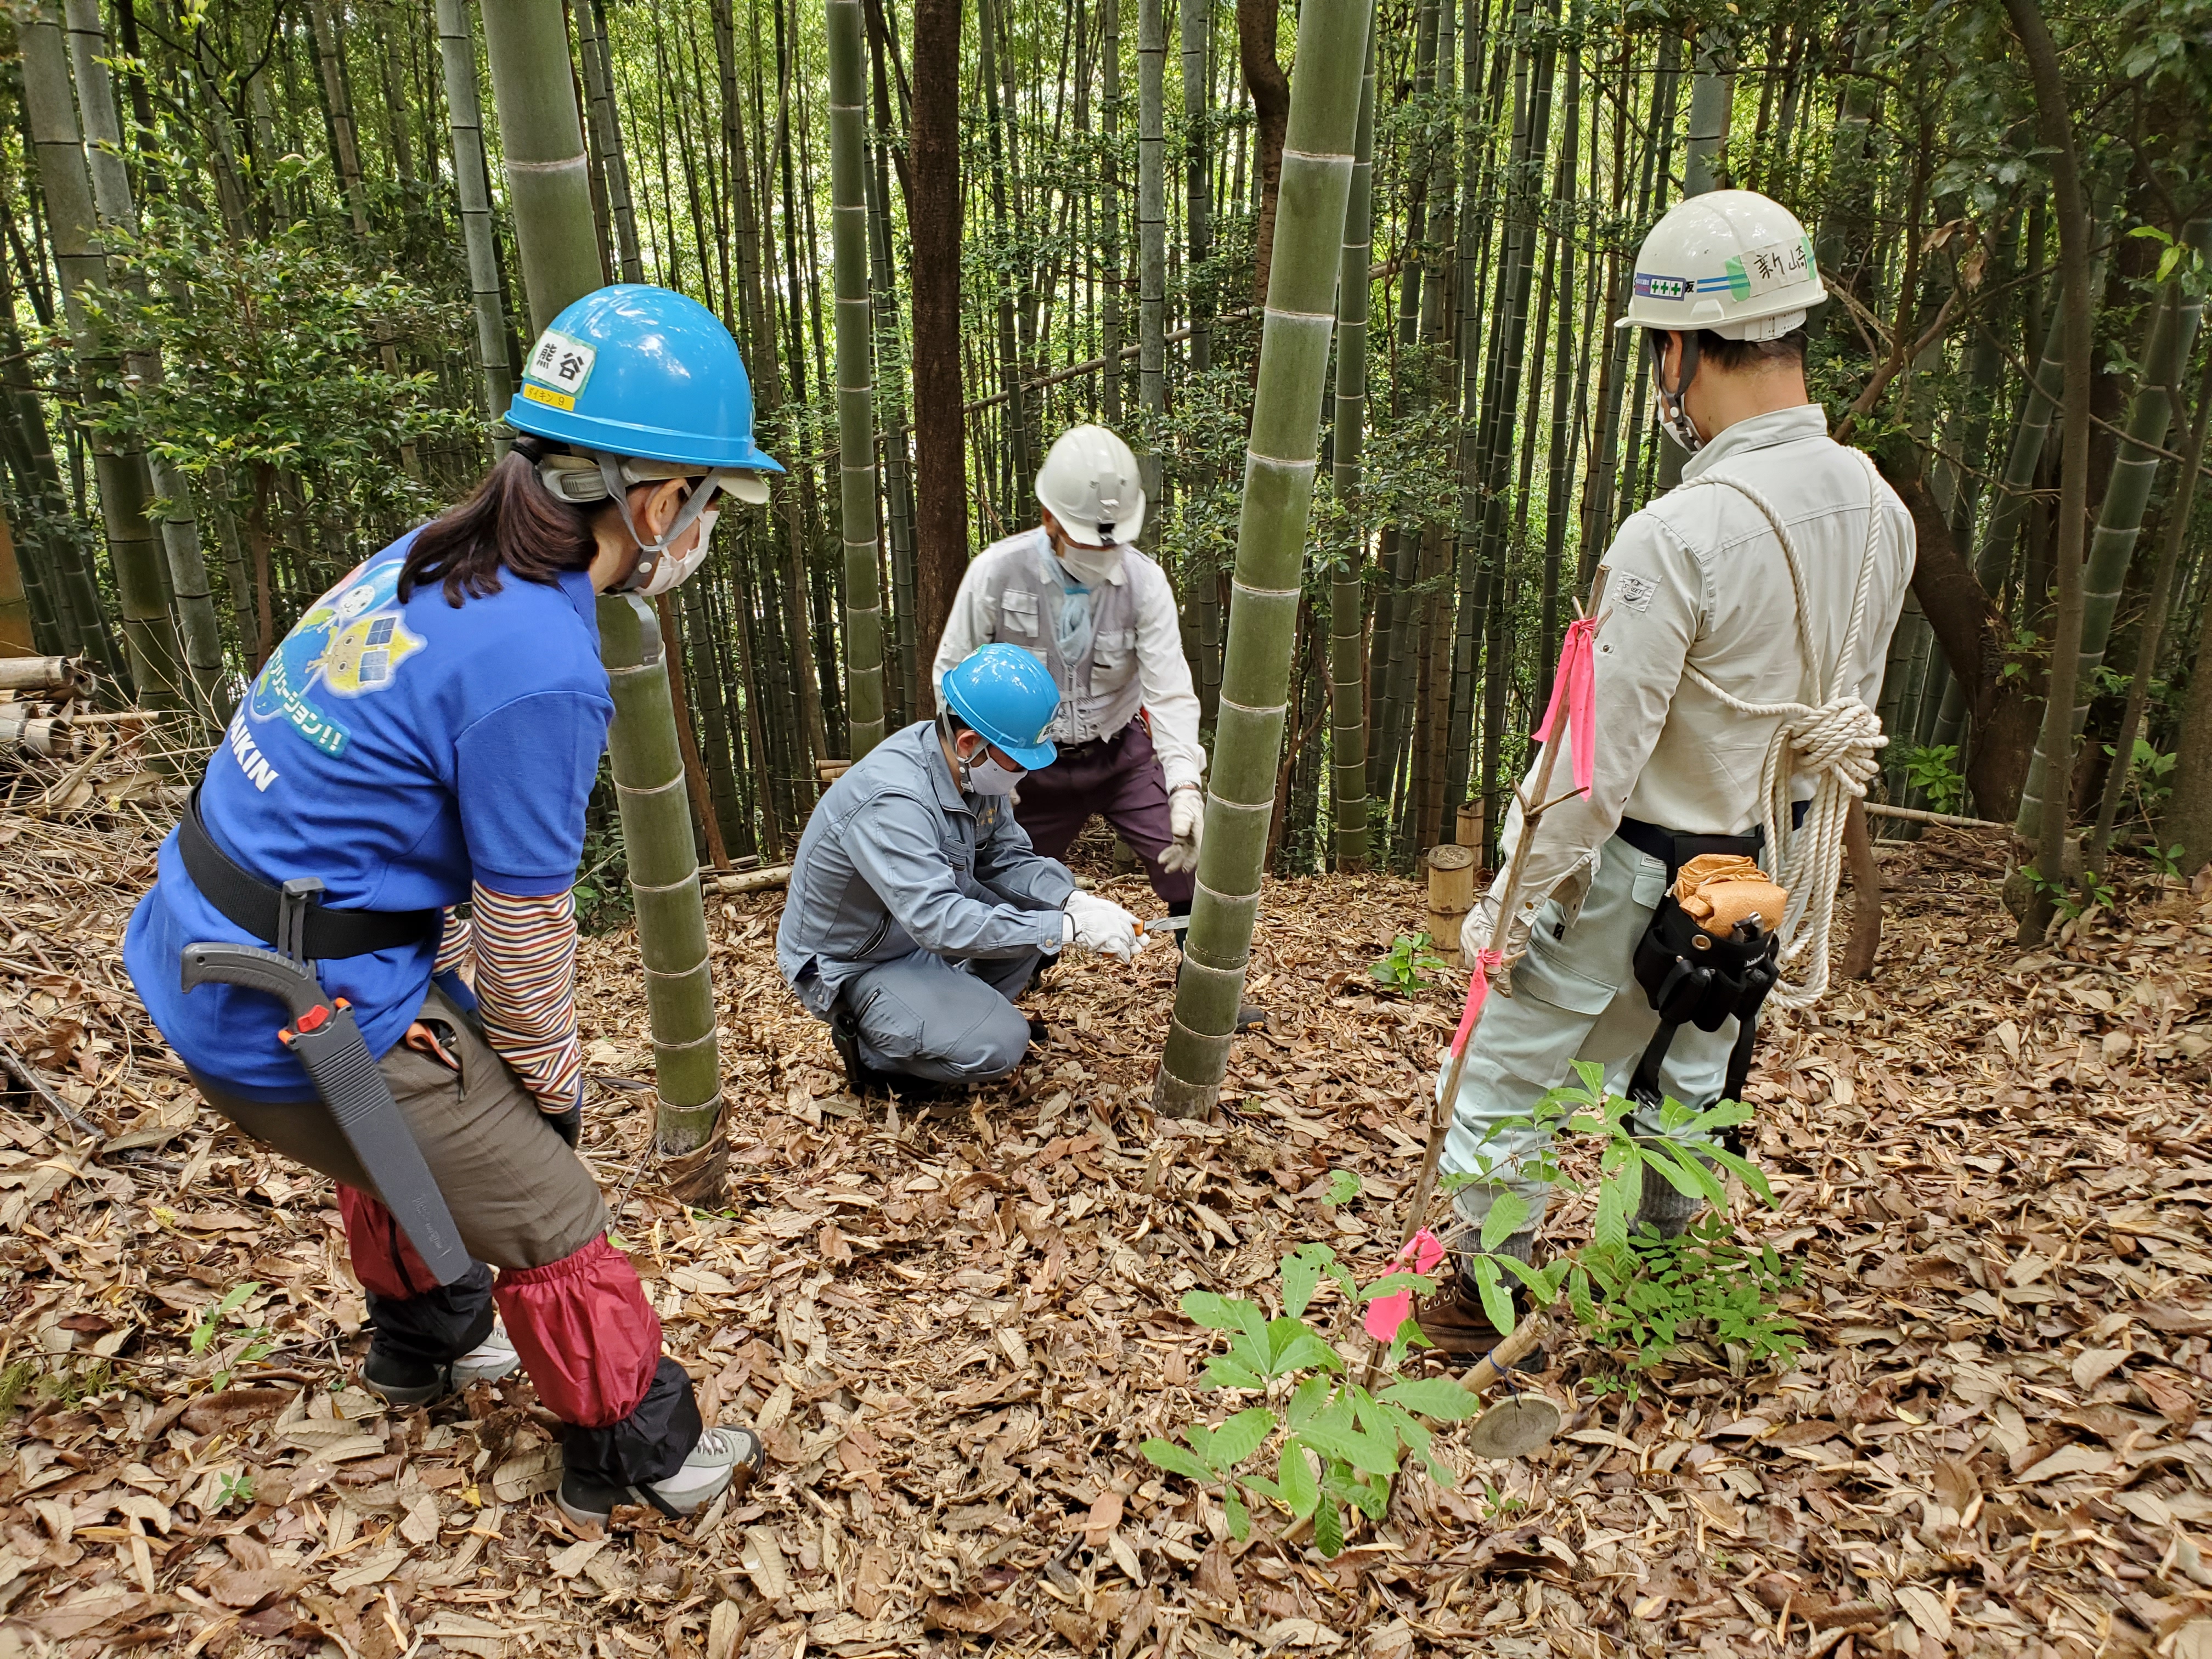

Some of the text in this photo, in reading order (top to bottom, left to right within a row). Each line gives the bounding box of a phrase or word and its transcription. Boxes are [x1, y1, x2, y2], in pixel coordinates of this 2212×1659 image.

[536, 342, 585, 381] 熊谷
[528, 387, 565, 406] ダイキン 9
